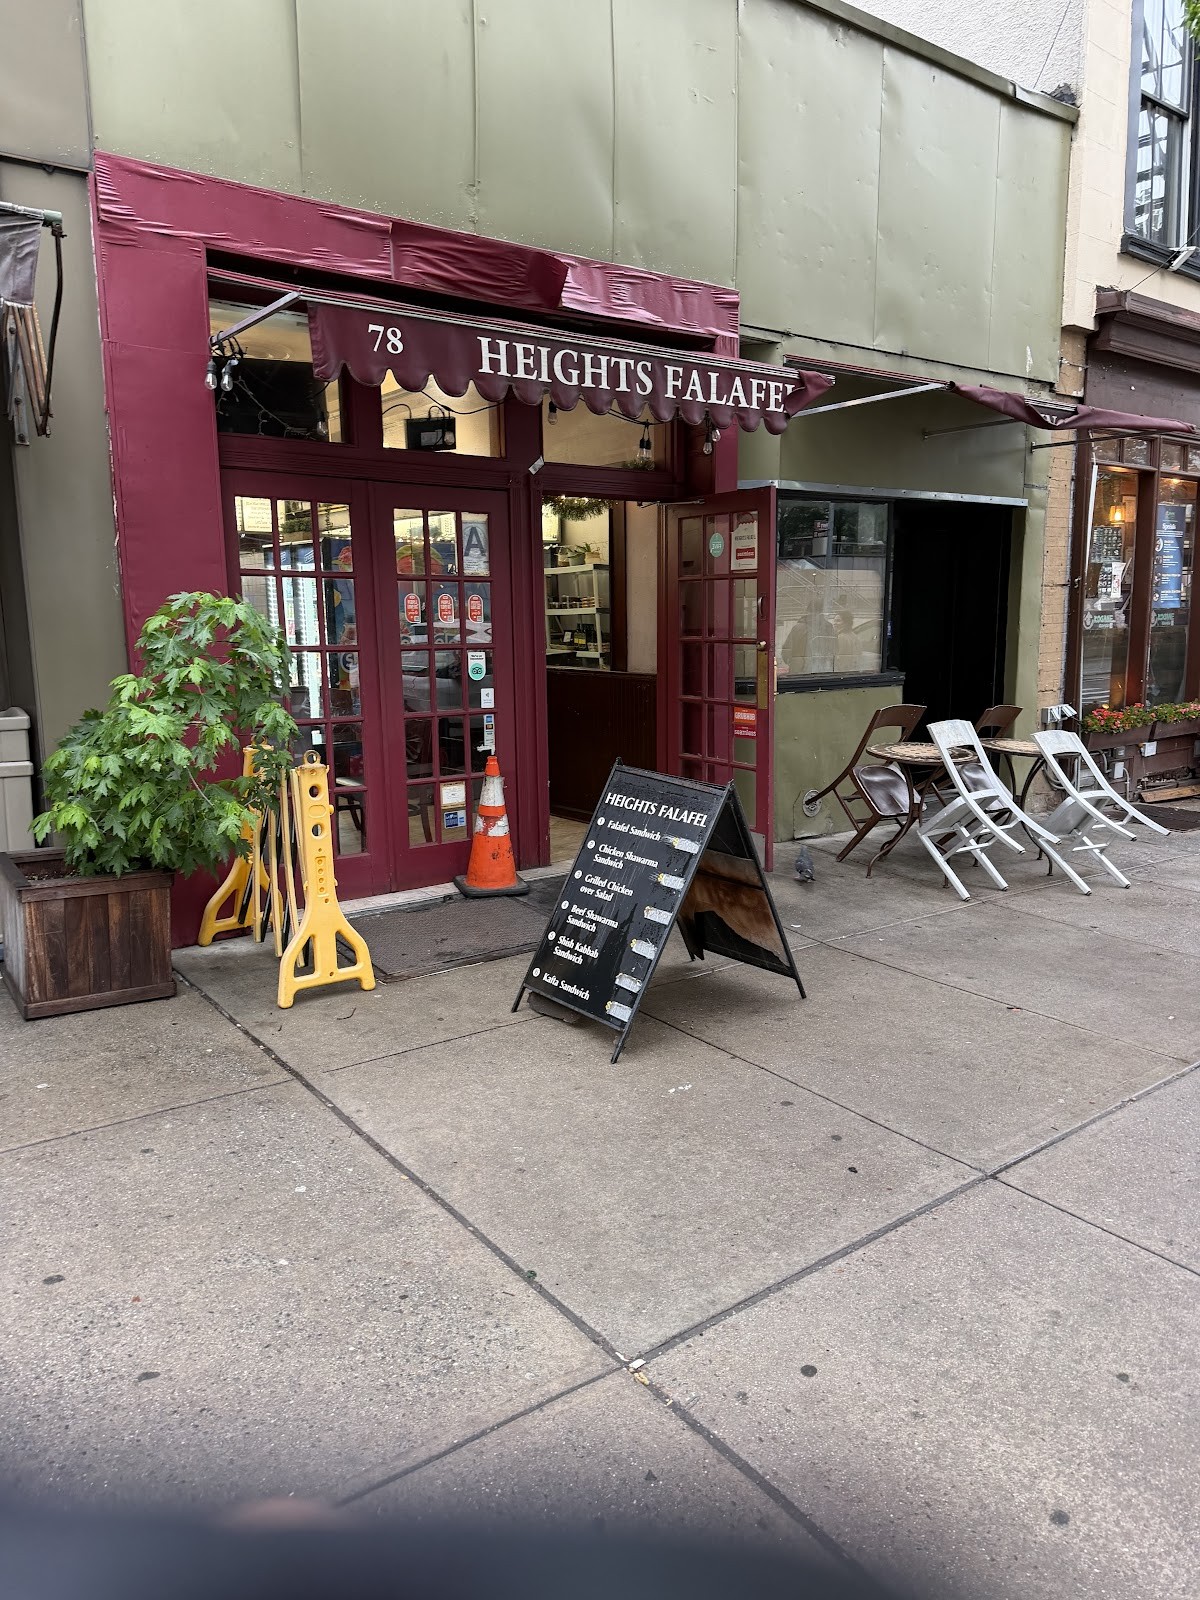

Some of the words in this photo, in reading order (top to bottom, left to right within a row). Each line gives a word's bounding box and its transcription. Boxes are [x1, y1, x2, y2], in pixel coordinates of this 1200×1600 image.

[368, 324, 404, 354] 78
[476, 336, 654, 396] HEIGHTS
[464, 526, 487, 557] A
[604, 792, 658, 815] HEIGHTS
[658, 805, 708, 828] FALAFEL
[607, 820, 630, 833] Falafel
[629, 826, 661, 841] Sandwich
[593, 854, 624, 870] Sandwich
[599, 844, 624, 859] Chicken
[624, 851, 659, 868] Shawarma
[580, 886, 595, 895] over
[595, 889, 615, 902] Salad
[585, 874, 608, 888] Grilled
[607, 881, 634, 896] Chicken
[566, 914, 597, 933] Sandwich
[571, 904, 587, 916] Beef
[586, 909, 619, 929] Shawarma
[553, 946, 584, 965] Sandwich
[557, 936, 575, 949] Shish
[574, 940, 599, 959] Kabbab
[559, 980, 590, 1000] Sandwich
